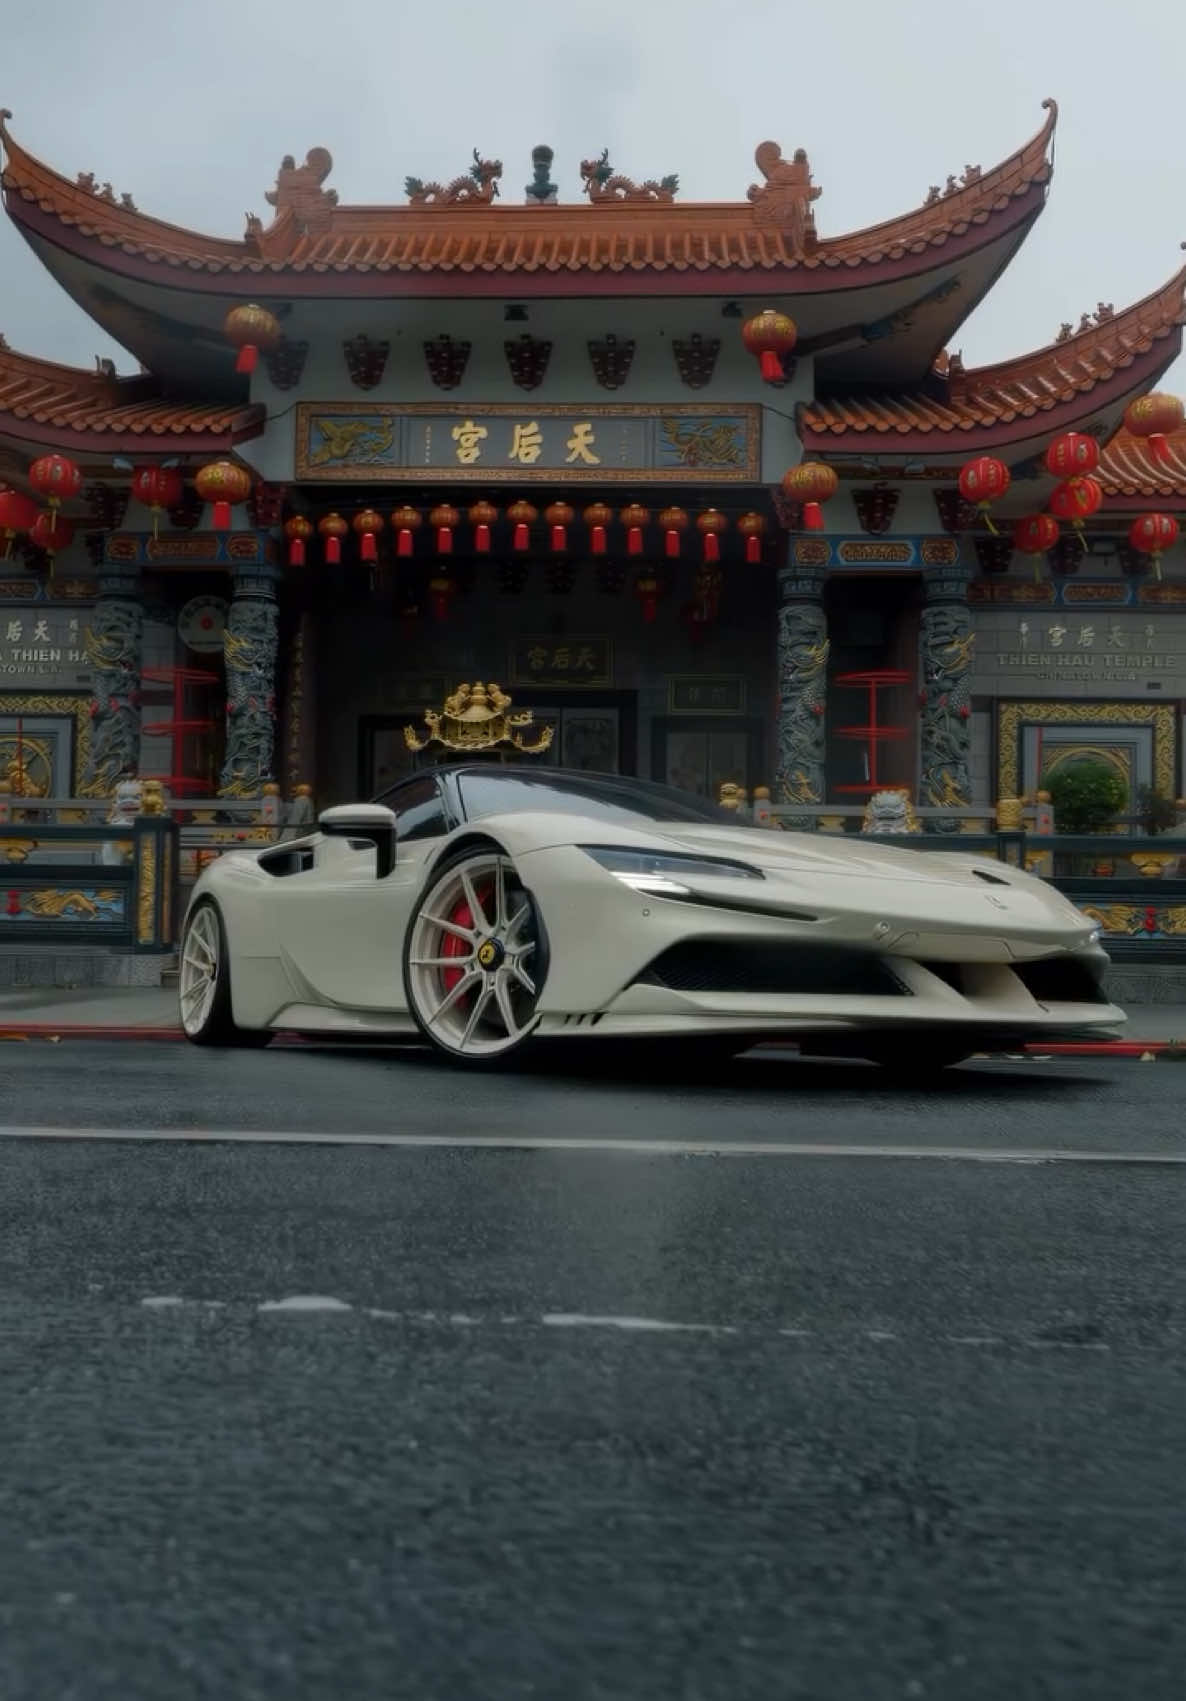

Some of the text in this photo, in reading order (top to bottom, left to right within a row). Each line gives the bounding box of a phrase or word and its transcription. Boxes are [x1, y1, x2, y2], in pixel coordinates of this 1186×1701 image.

[12, 648, 61, 661] THIEN
[997, 654, 1177, 667] THIEN HAU TEMPLE
